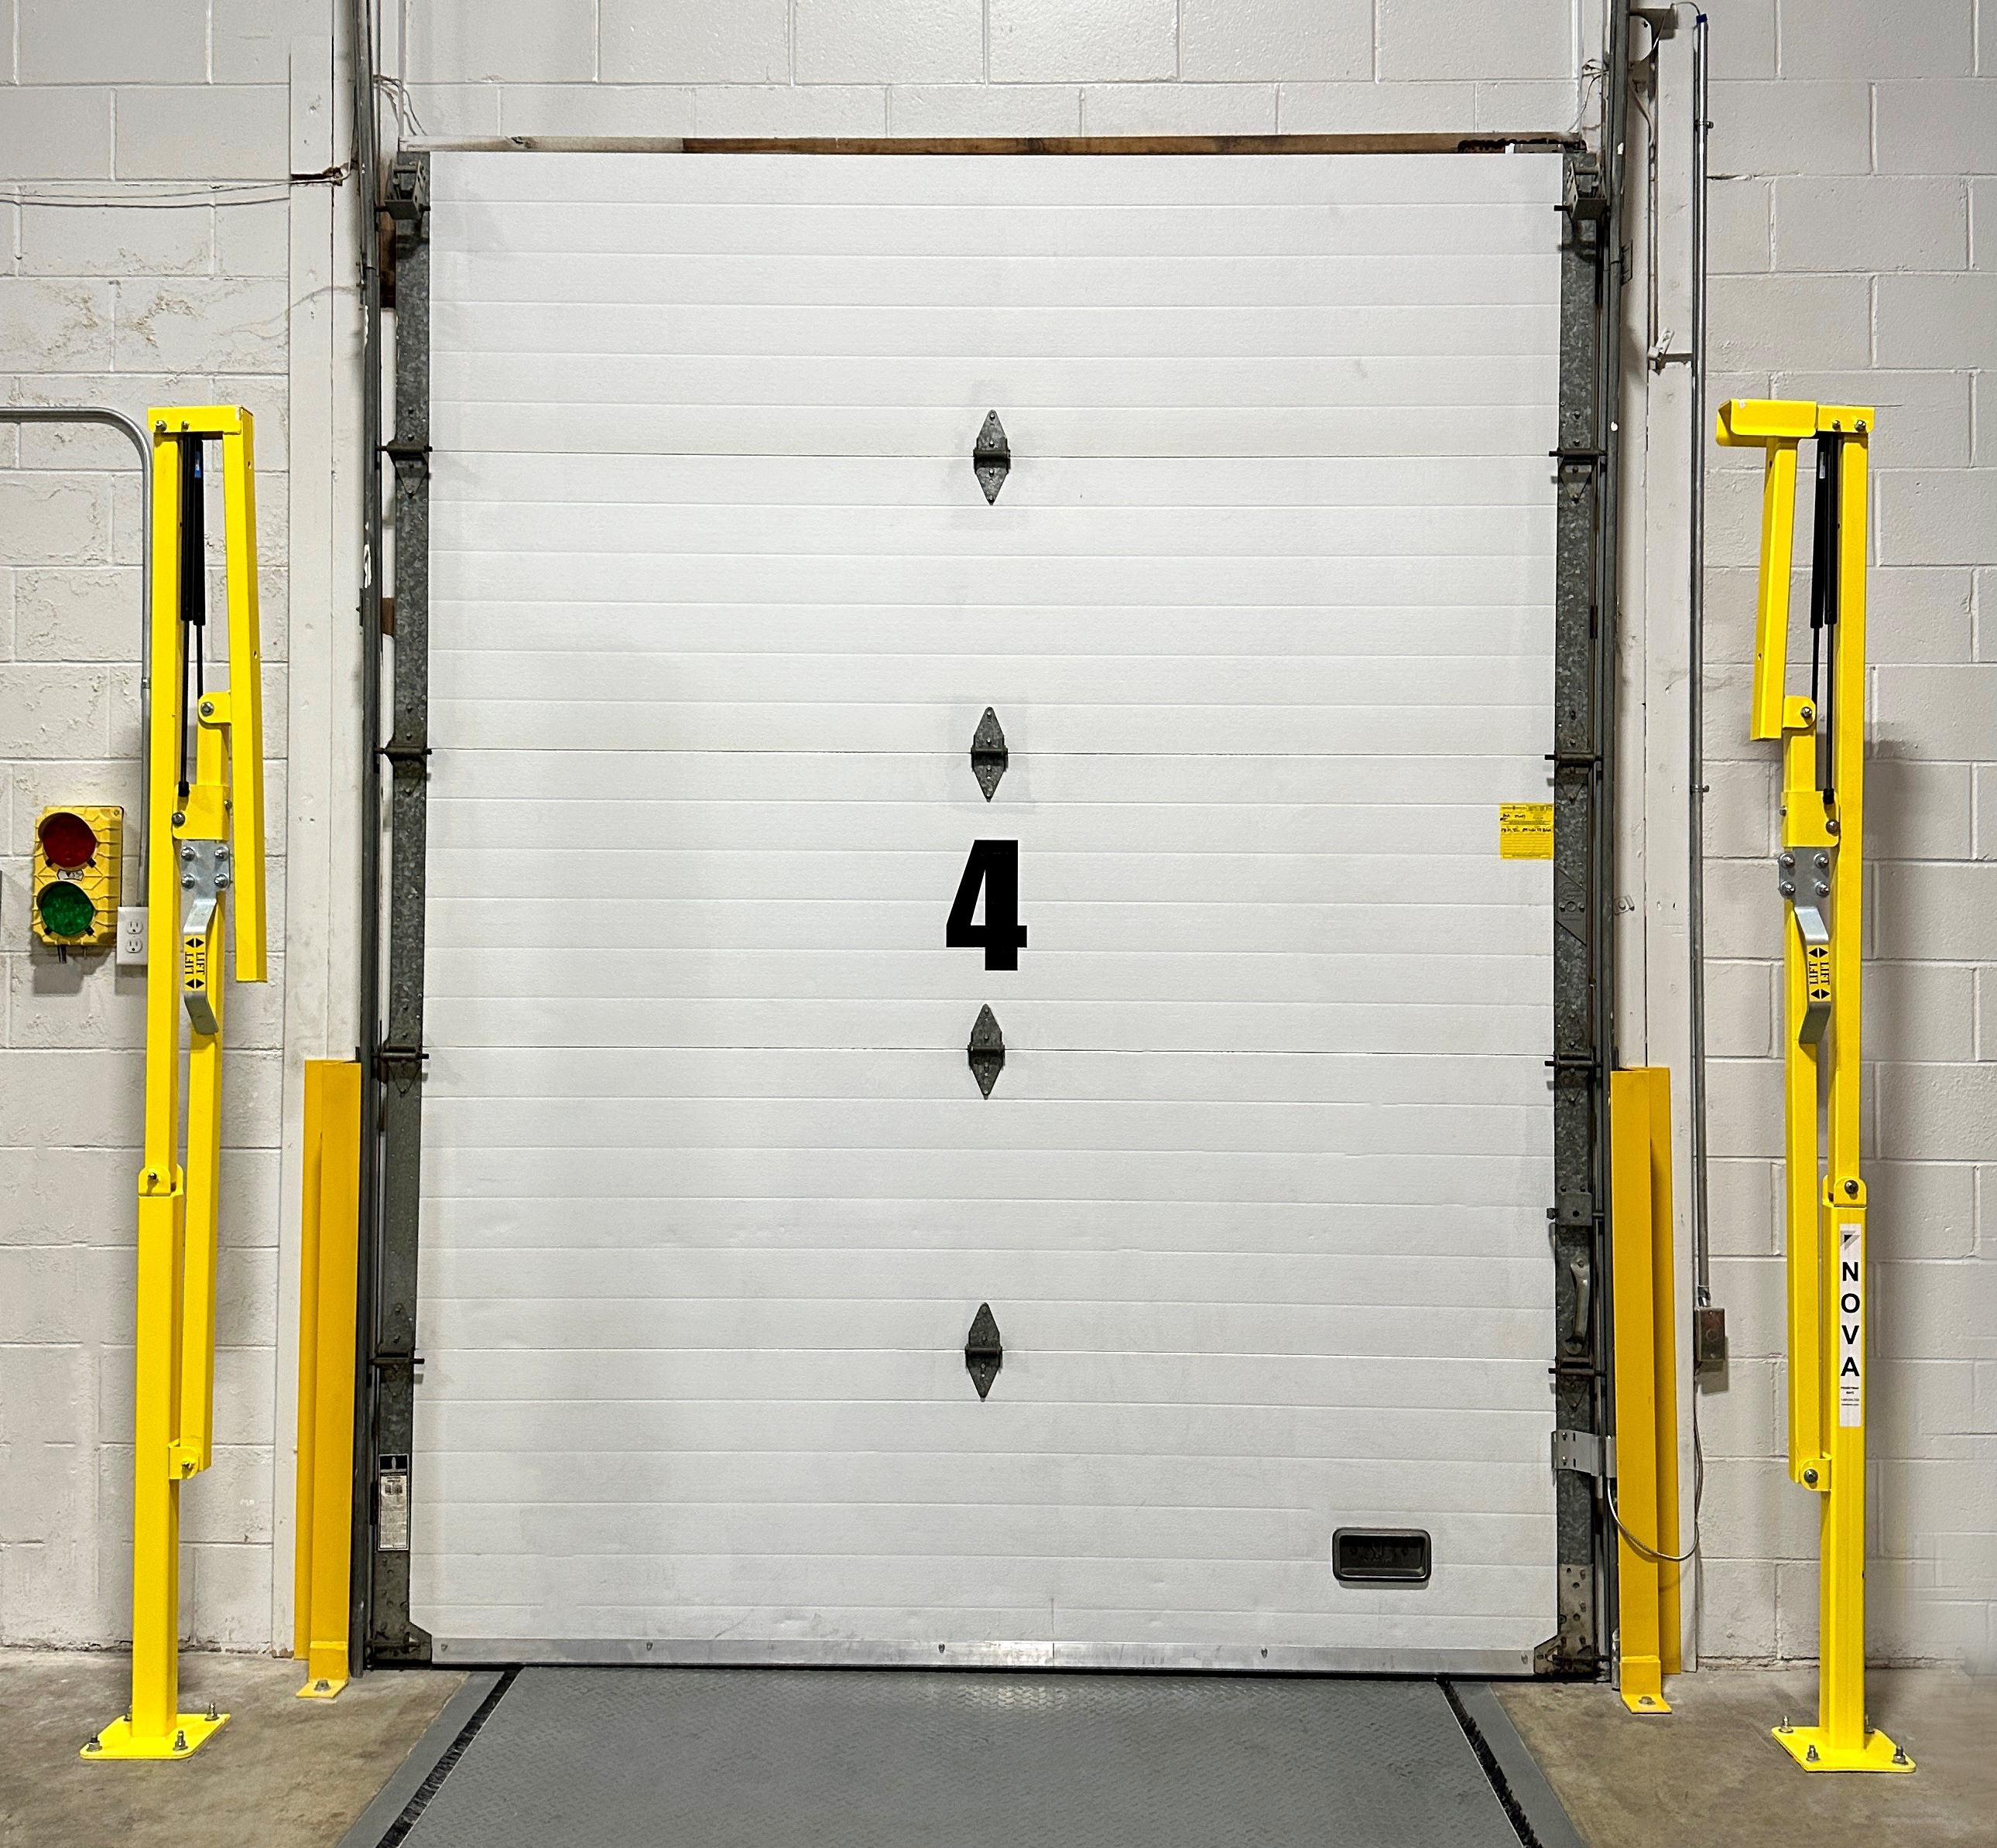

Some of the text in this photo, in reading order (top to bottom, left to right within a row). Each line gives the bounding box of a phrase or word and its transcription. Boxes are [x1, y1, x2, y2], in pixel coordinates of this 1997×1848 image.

[947, 840, 1027, 970] 4
[184, 951, 194, 975] LIFT
[196, 951, 205, 975] LIFT
[1808, 961, 1819, 985] LIFT
[1820, 961, 1831, 985] LIFT
[1840, 1261, 1861, 1377] NOVA
